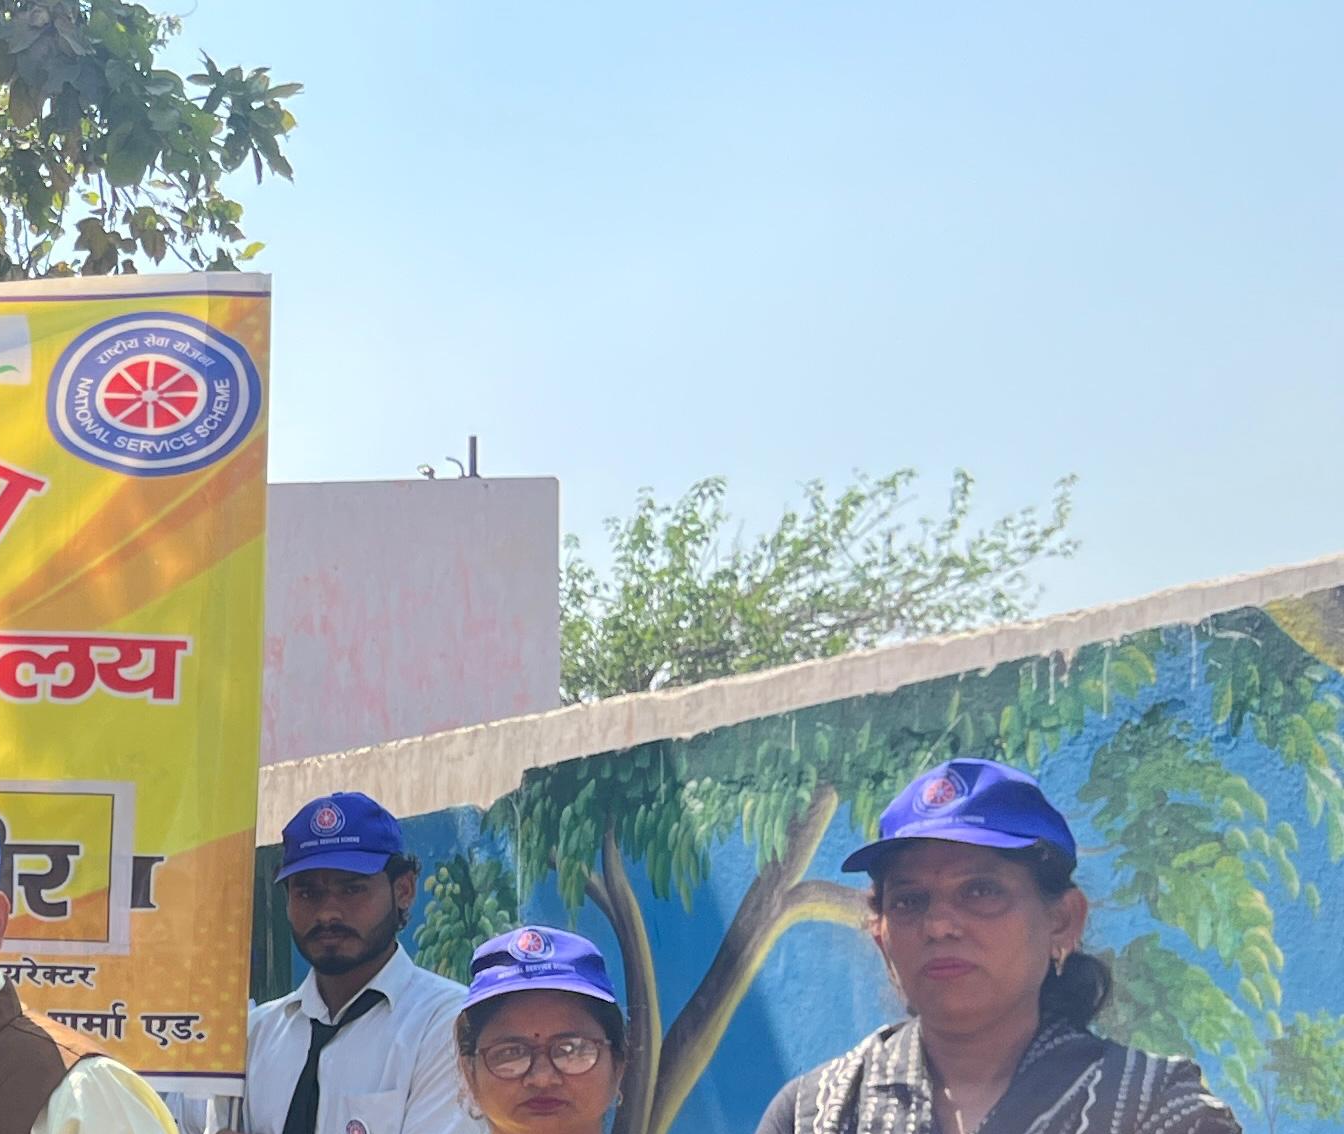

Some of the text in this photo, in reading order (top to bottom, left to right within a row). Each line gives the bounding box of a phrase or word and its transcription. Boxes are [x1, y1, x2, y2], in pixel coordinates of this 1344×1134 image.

[74, 377, 230, 454] NATIONAL SERVICE SCHEME
[141, 1015, 206, 1046] एड.
